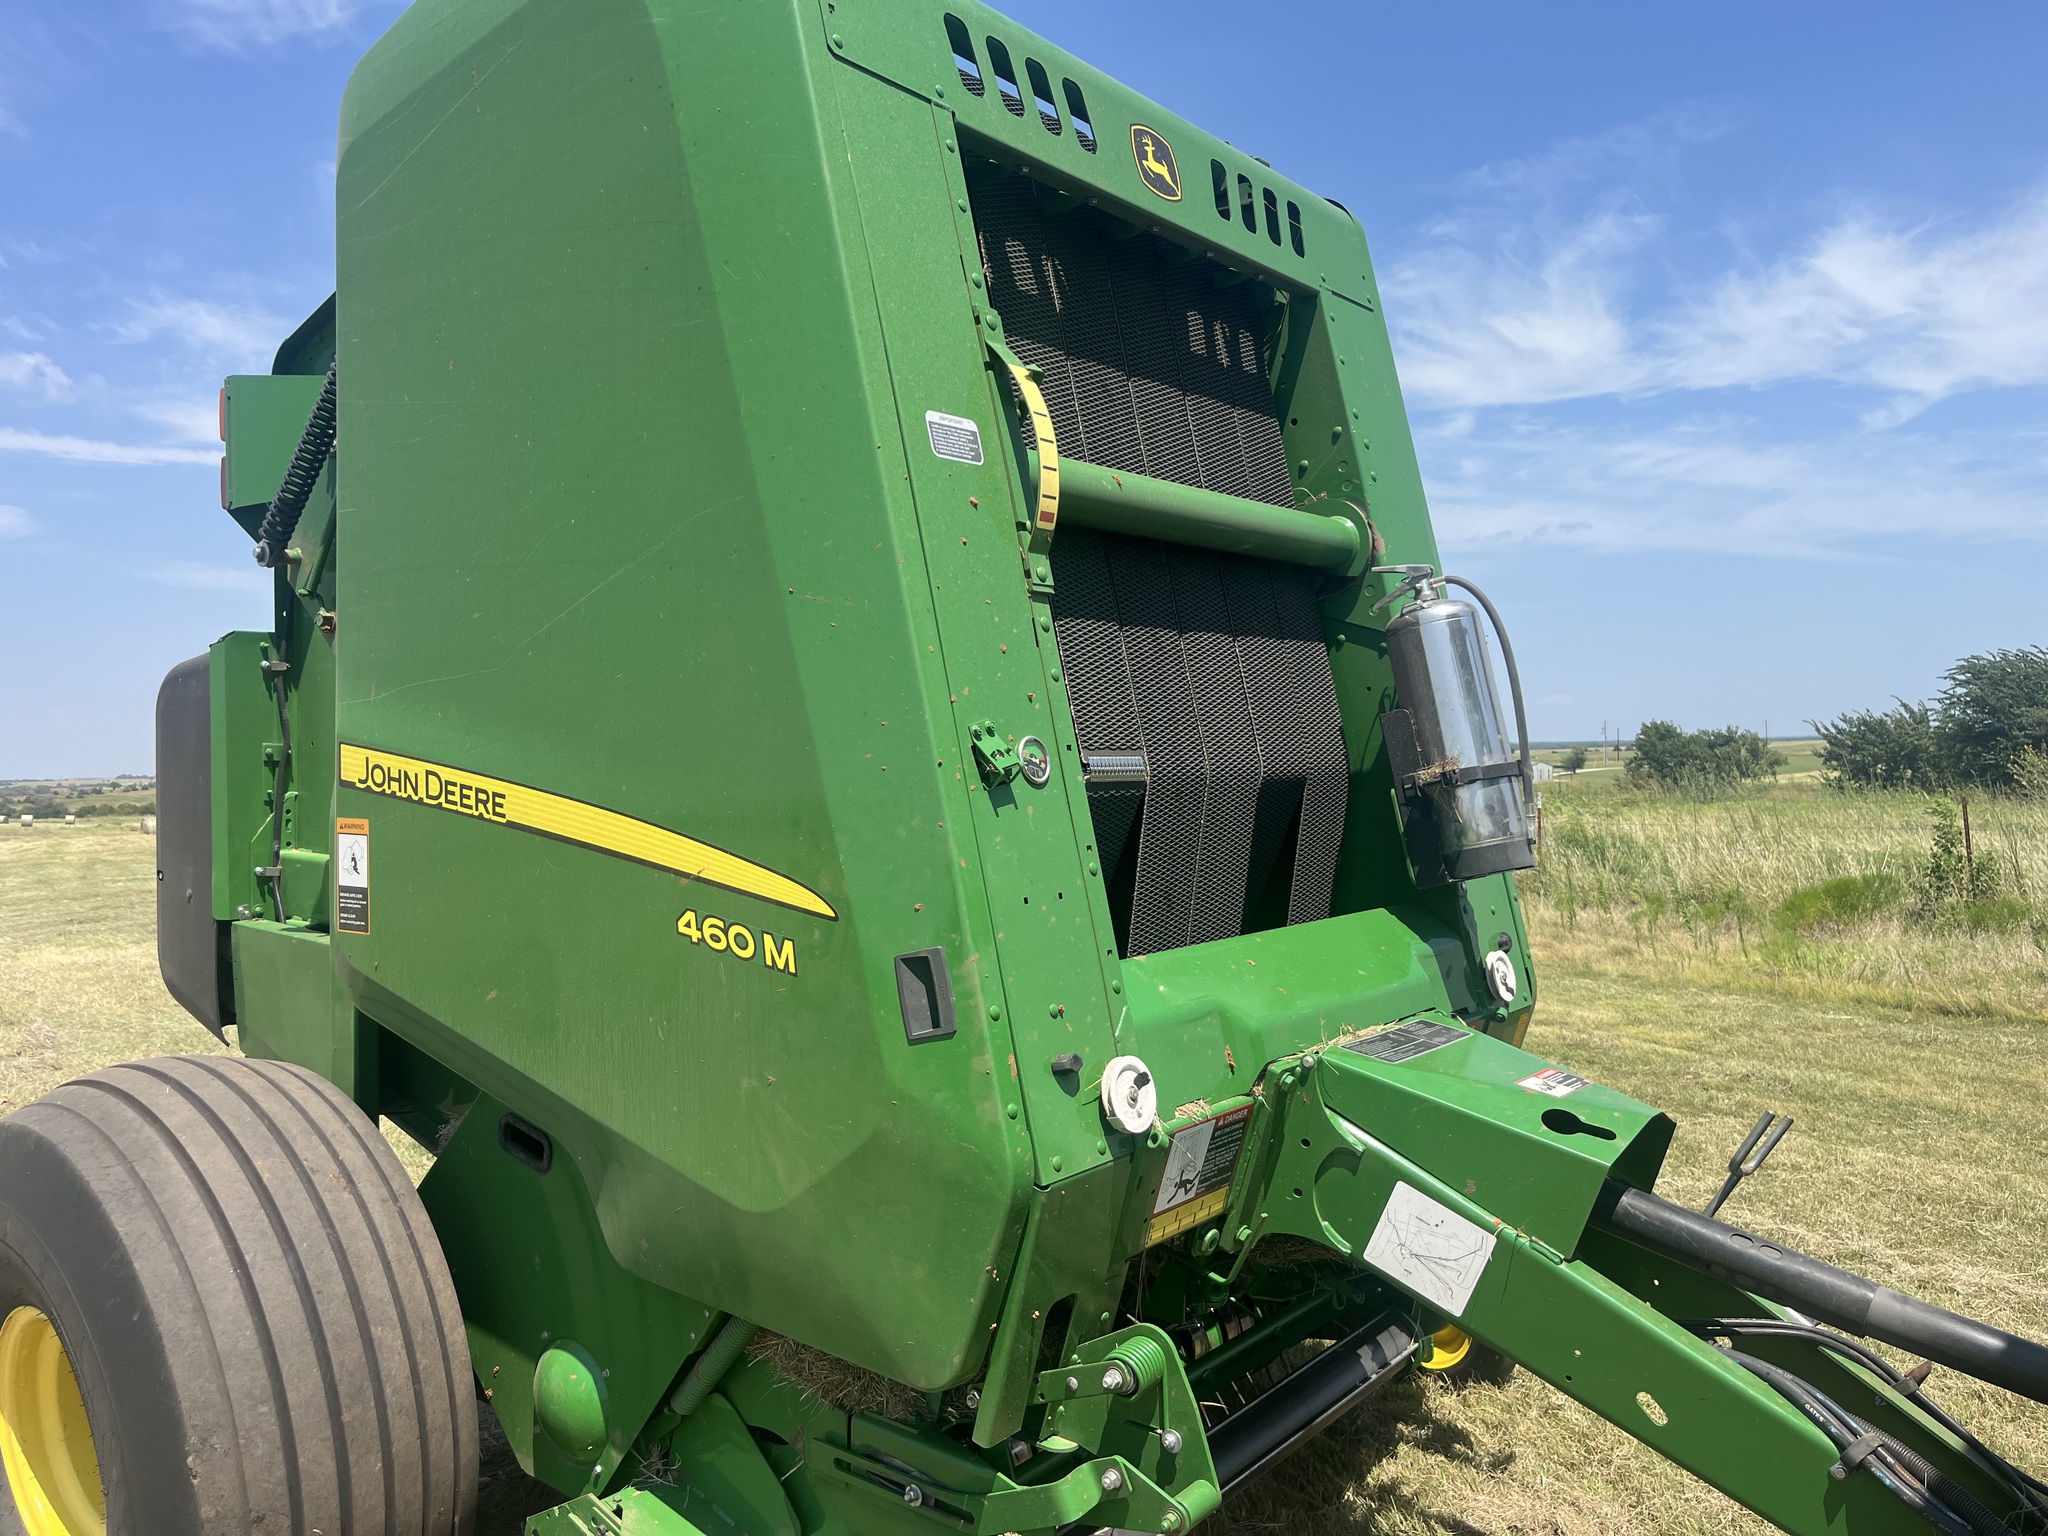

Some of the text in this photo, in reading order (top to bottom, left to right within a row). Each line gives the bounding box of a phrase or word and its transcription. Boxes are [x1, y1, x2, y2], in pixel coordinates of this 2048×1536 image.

[357, 756, 507, 819] JOHN DEERE
[676, 908, 798, 976] 460 M
[1224, 1109, 1248, 1123] DANGER
[1804, 1403, 1825, 1422] GATES
